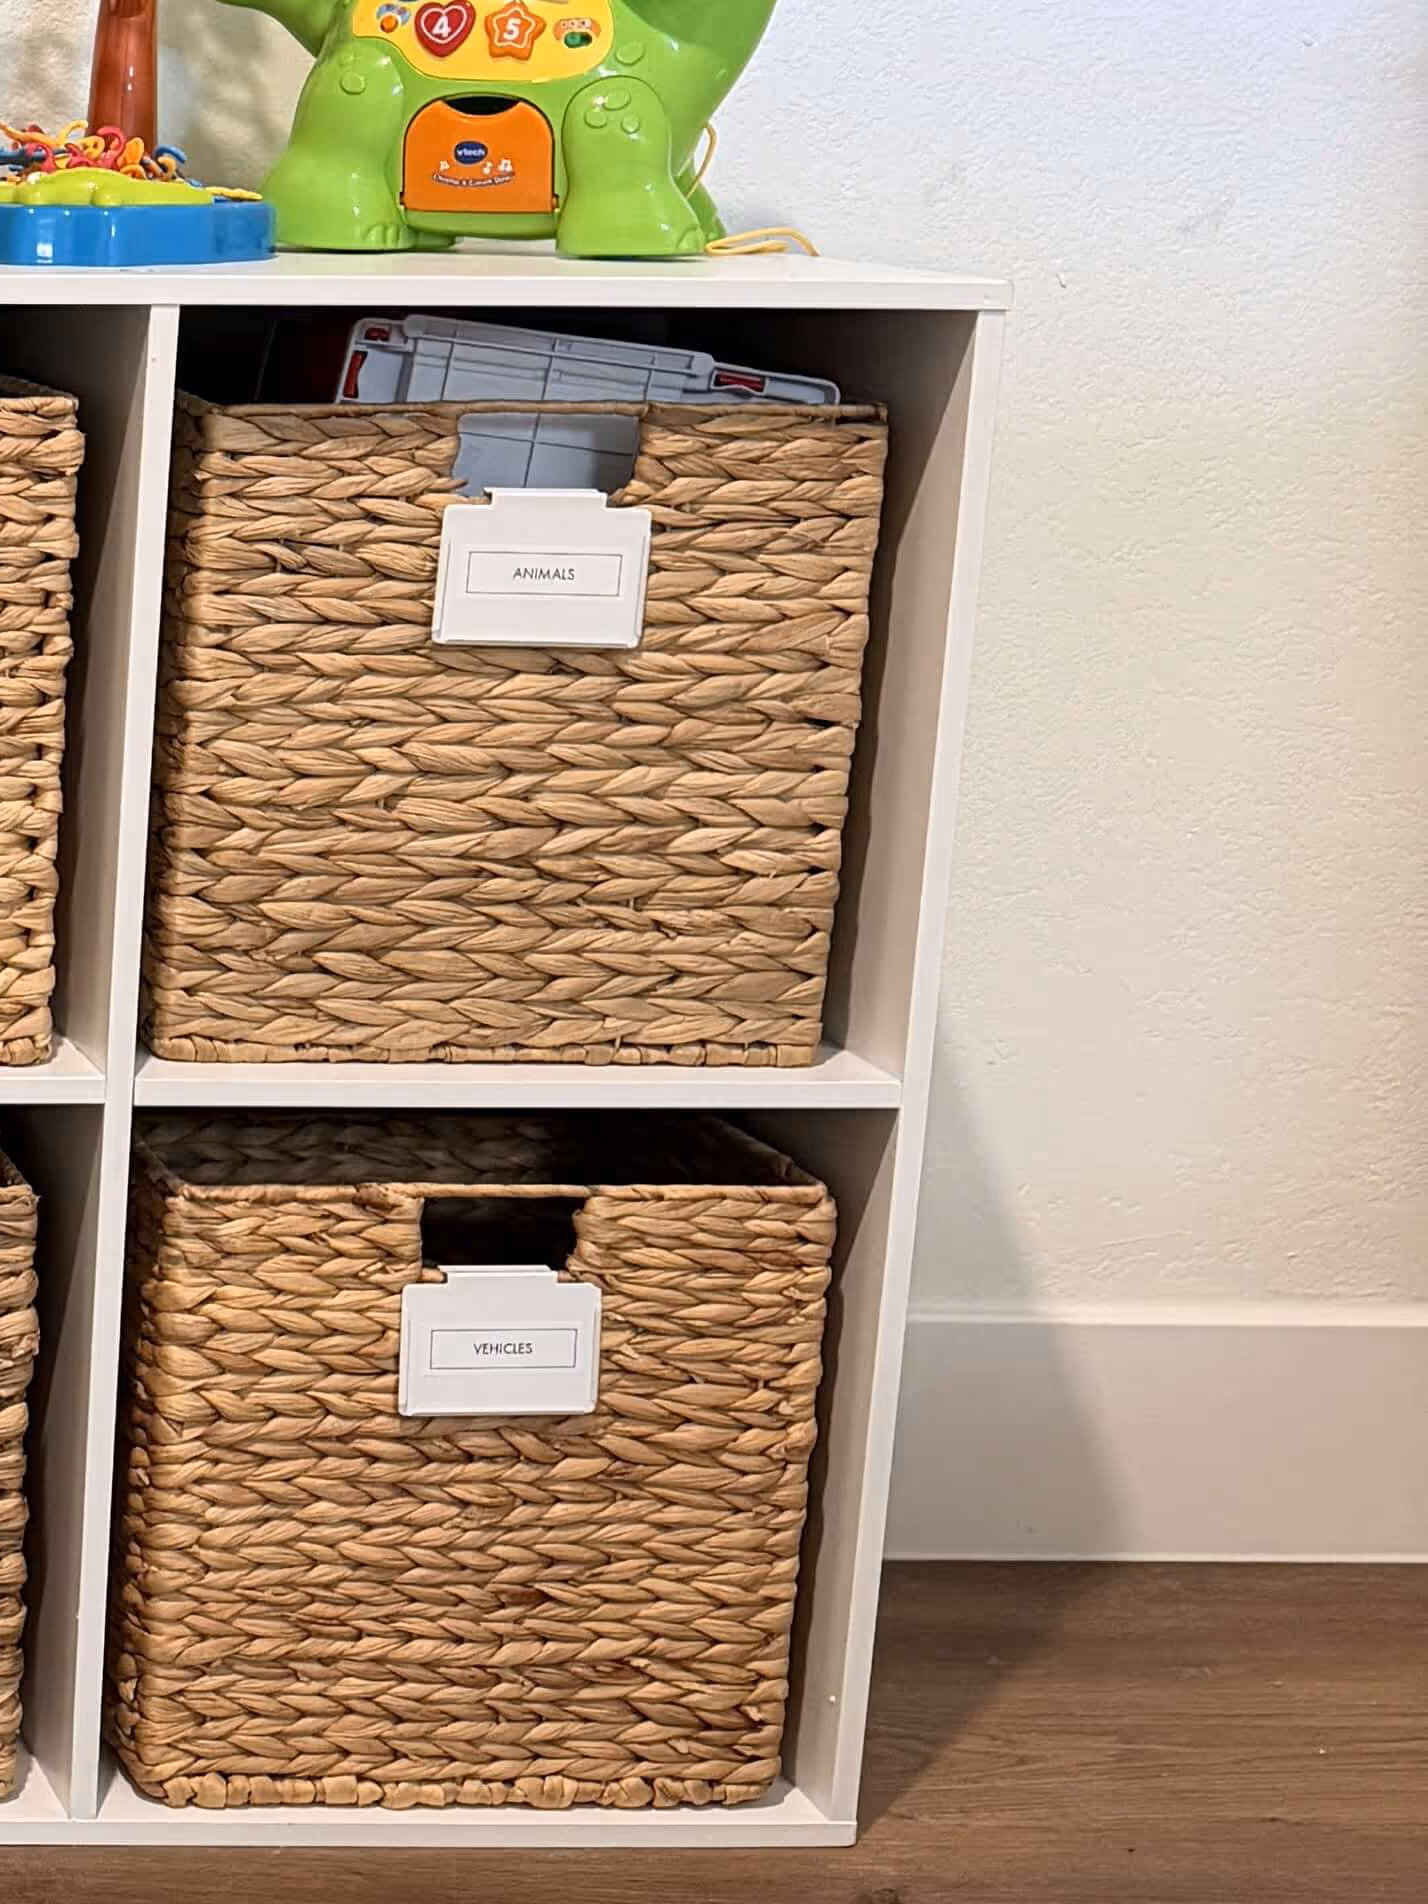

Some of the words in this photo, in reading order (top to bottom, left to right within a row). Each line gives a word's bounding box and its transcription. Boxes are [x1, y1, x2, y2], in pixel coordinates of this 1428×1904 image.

[432, 16, 452, 38] 4
[503, 18, 522, 40] 5
[512, 567, 575, 581] ANIMALS
[473, 1342, 534, 1356] VEHICLES
